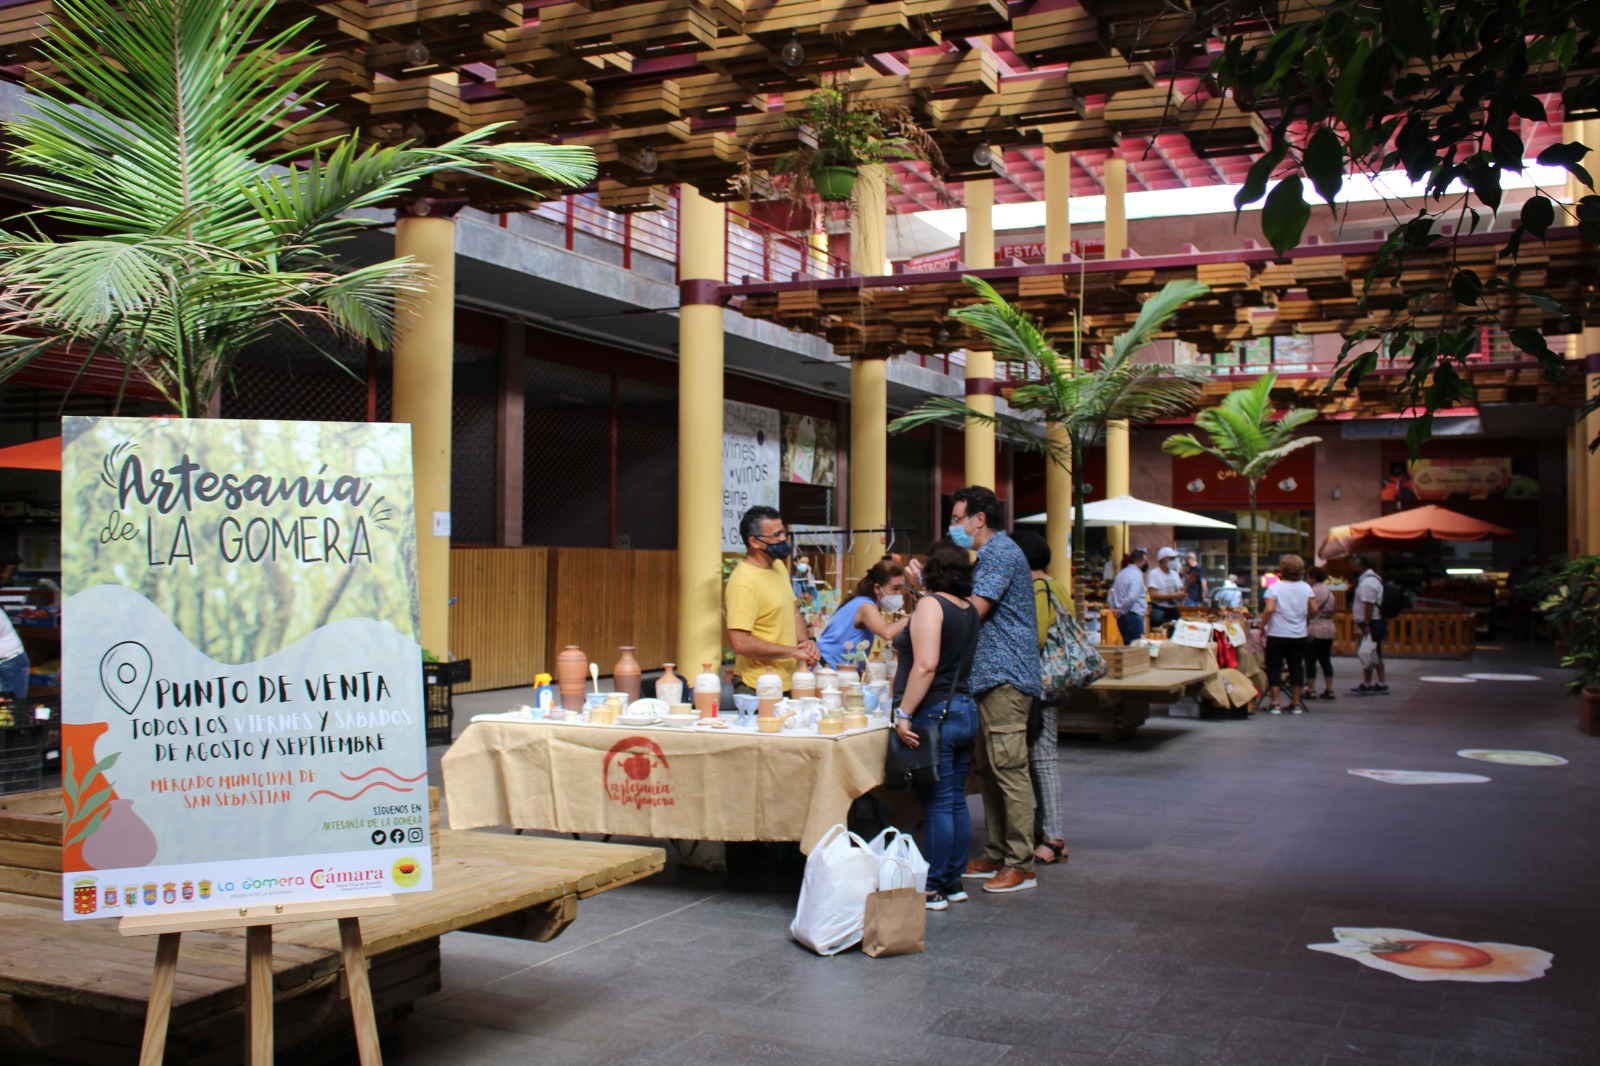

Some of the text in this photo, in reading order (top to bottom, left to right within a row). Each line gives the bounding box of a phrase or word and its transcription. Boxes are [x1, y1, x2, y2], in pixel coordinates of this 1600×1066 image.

[1004, 242, 1077, 258] ESTACN
[119, 453, 372, 515] Artesanía
[734, 461, 769, 485] vinos
[722, 485, 749, 507] eine
[100, 510, 373, 566] de LA GOMERA
[156, 671, 392, 710] PUNTO DE VENTA
[130, 706, 413, 740] TODOS LOS VIERNES Y SÁBADOS
[155, 733, 387, 762] DE AGOSTO Y SEPTIEMBRE
[151, 769, 316, 793] MERCADO MUNICIPAL DE
[184, 789, 291, 809] SAN SEBASTIÁN
[373, 803, 421, 816] SÍGUENOS EN
[322, 815, 423, 831] ARTESANÍA DE LA GOMERA
[310, 866, 384, 889] Cámara
